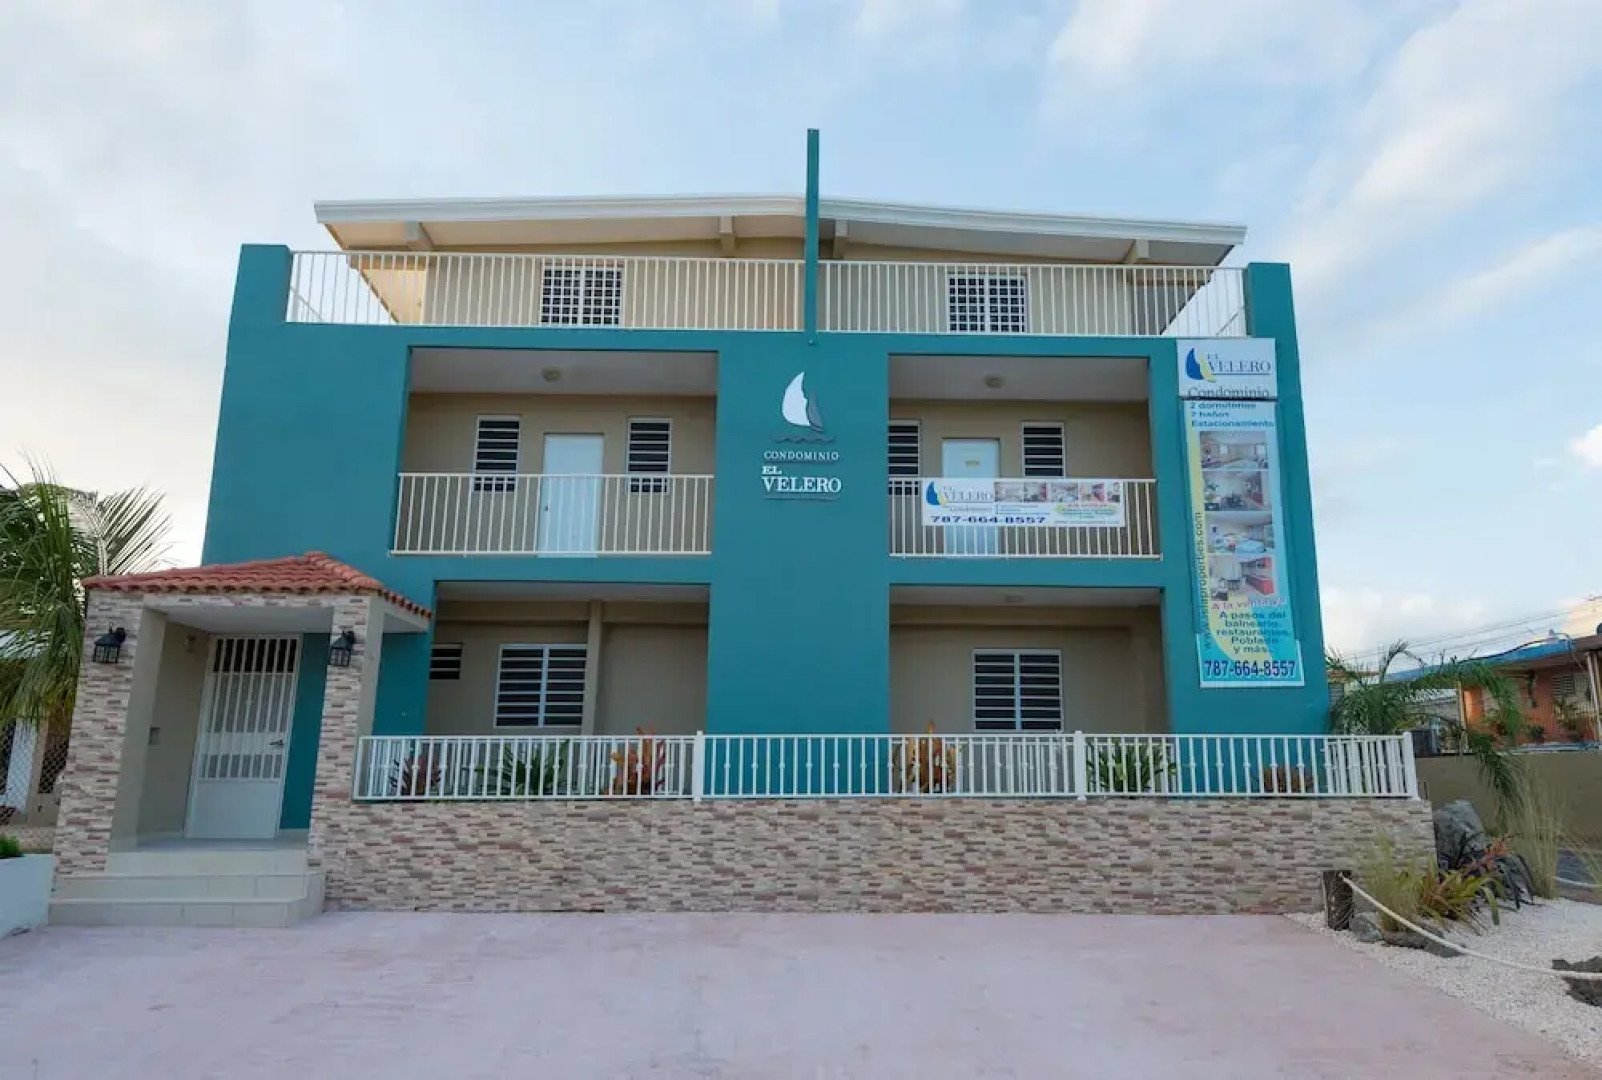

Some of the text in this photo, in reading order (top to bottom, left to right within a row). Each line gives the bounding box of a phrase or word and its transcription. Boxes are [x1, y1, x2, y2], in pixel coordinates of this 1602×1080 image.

[1208, 361, 1271, 372] VELERO
[1188, 386, 1270, 398] Condominio
[763, 451, 840, 461] CONDOMINIO
[762, 465, 782, 475] EL
[762, 476, 842, 493] VELERO
[944, 491, 993, 501] VELERO
[1205, 660, 1295, 677] 787-664-8557
